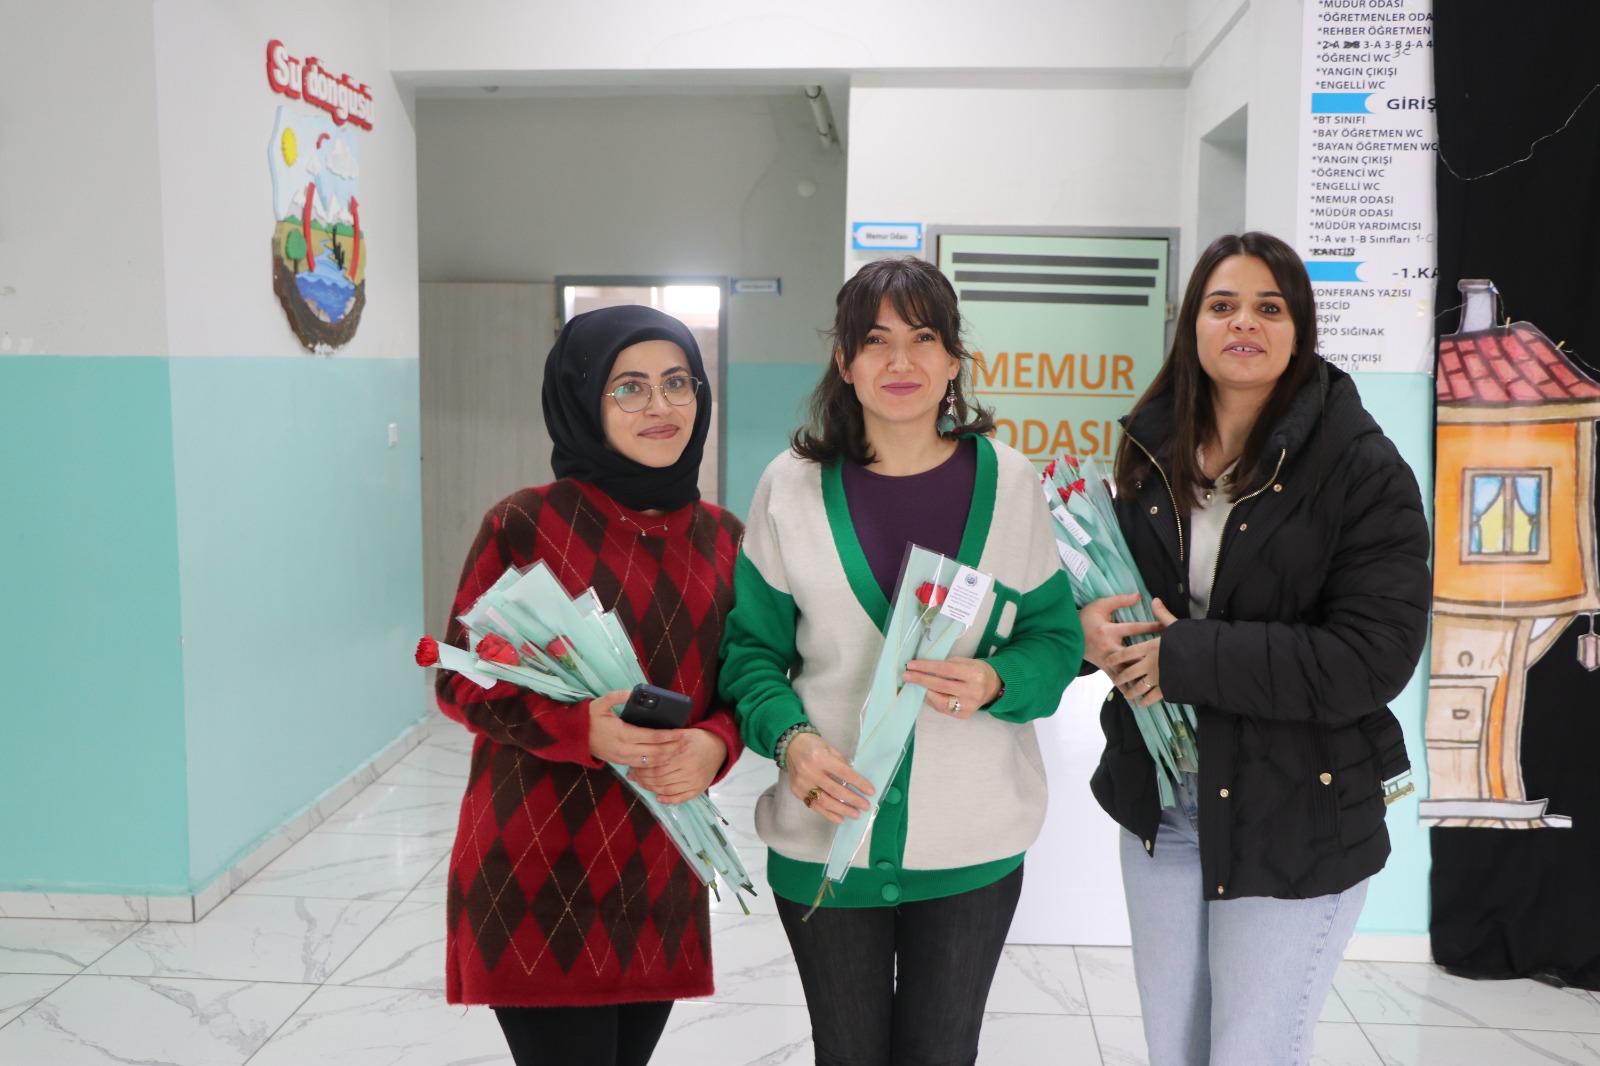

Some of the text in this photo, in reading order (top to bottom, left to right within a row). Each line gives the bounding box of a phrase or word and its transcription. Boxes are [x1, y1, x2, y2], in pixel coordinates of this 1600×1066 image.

[1368, 25, 1431, 35] ÖĞRETMEN
[1364, 41, 1381, 49] 3-A
[1385, 41, 1402, 49] 3-B
[1405, 41, 1423, 49] 4-A
[1373, 54, 1391, 62] WC
[269, 42, 301, 96] Su
[1366, 68, 1397, 78] ÇIKIŞI
[1368, 81, 1385, 89] WC
[1334, 116, 1365, 124] SINIFI
[1341, 128, 1403, 138] ÖĞRETMEN
[1406, 129, 1423, 138] WC
[1356, 141, 1417, 151] ÖĞRETMEN
[1420, 143, 1438, 151] WC
[1361, 156, 1392, 166] ÇIKIŞI
[1368, 169, 1385, 177] WC
[1363, 182, 1380, 190] WC
[1359, 195, 1394, 204] ODASI
[1359, 208, 1393, 217] ODASI
[1359, 222, 1421, 230] YARDIMCISI
[1350, 235, 1366, 243] 1-B
[1377, 289, 1411, 297] YAZISI
[1316, 326, 1384, 336] EPO SIĞINAK
[1351, 353, 1382, 363] ÇIKIŞI
[971, 351, 1136, 391] MEMUR
[988, 418, 1112, 457] ODASI
